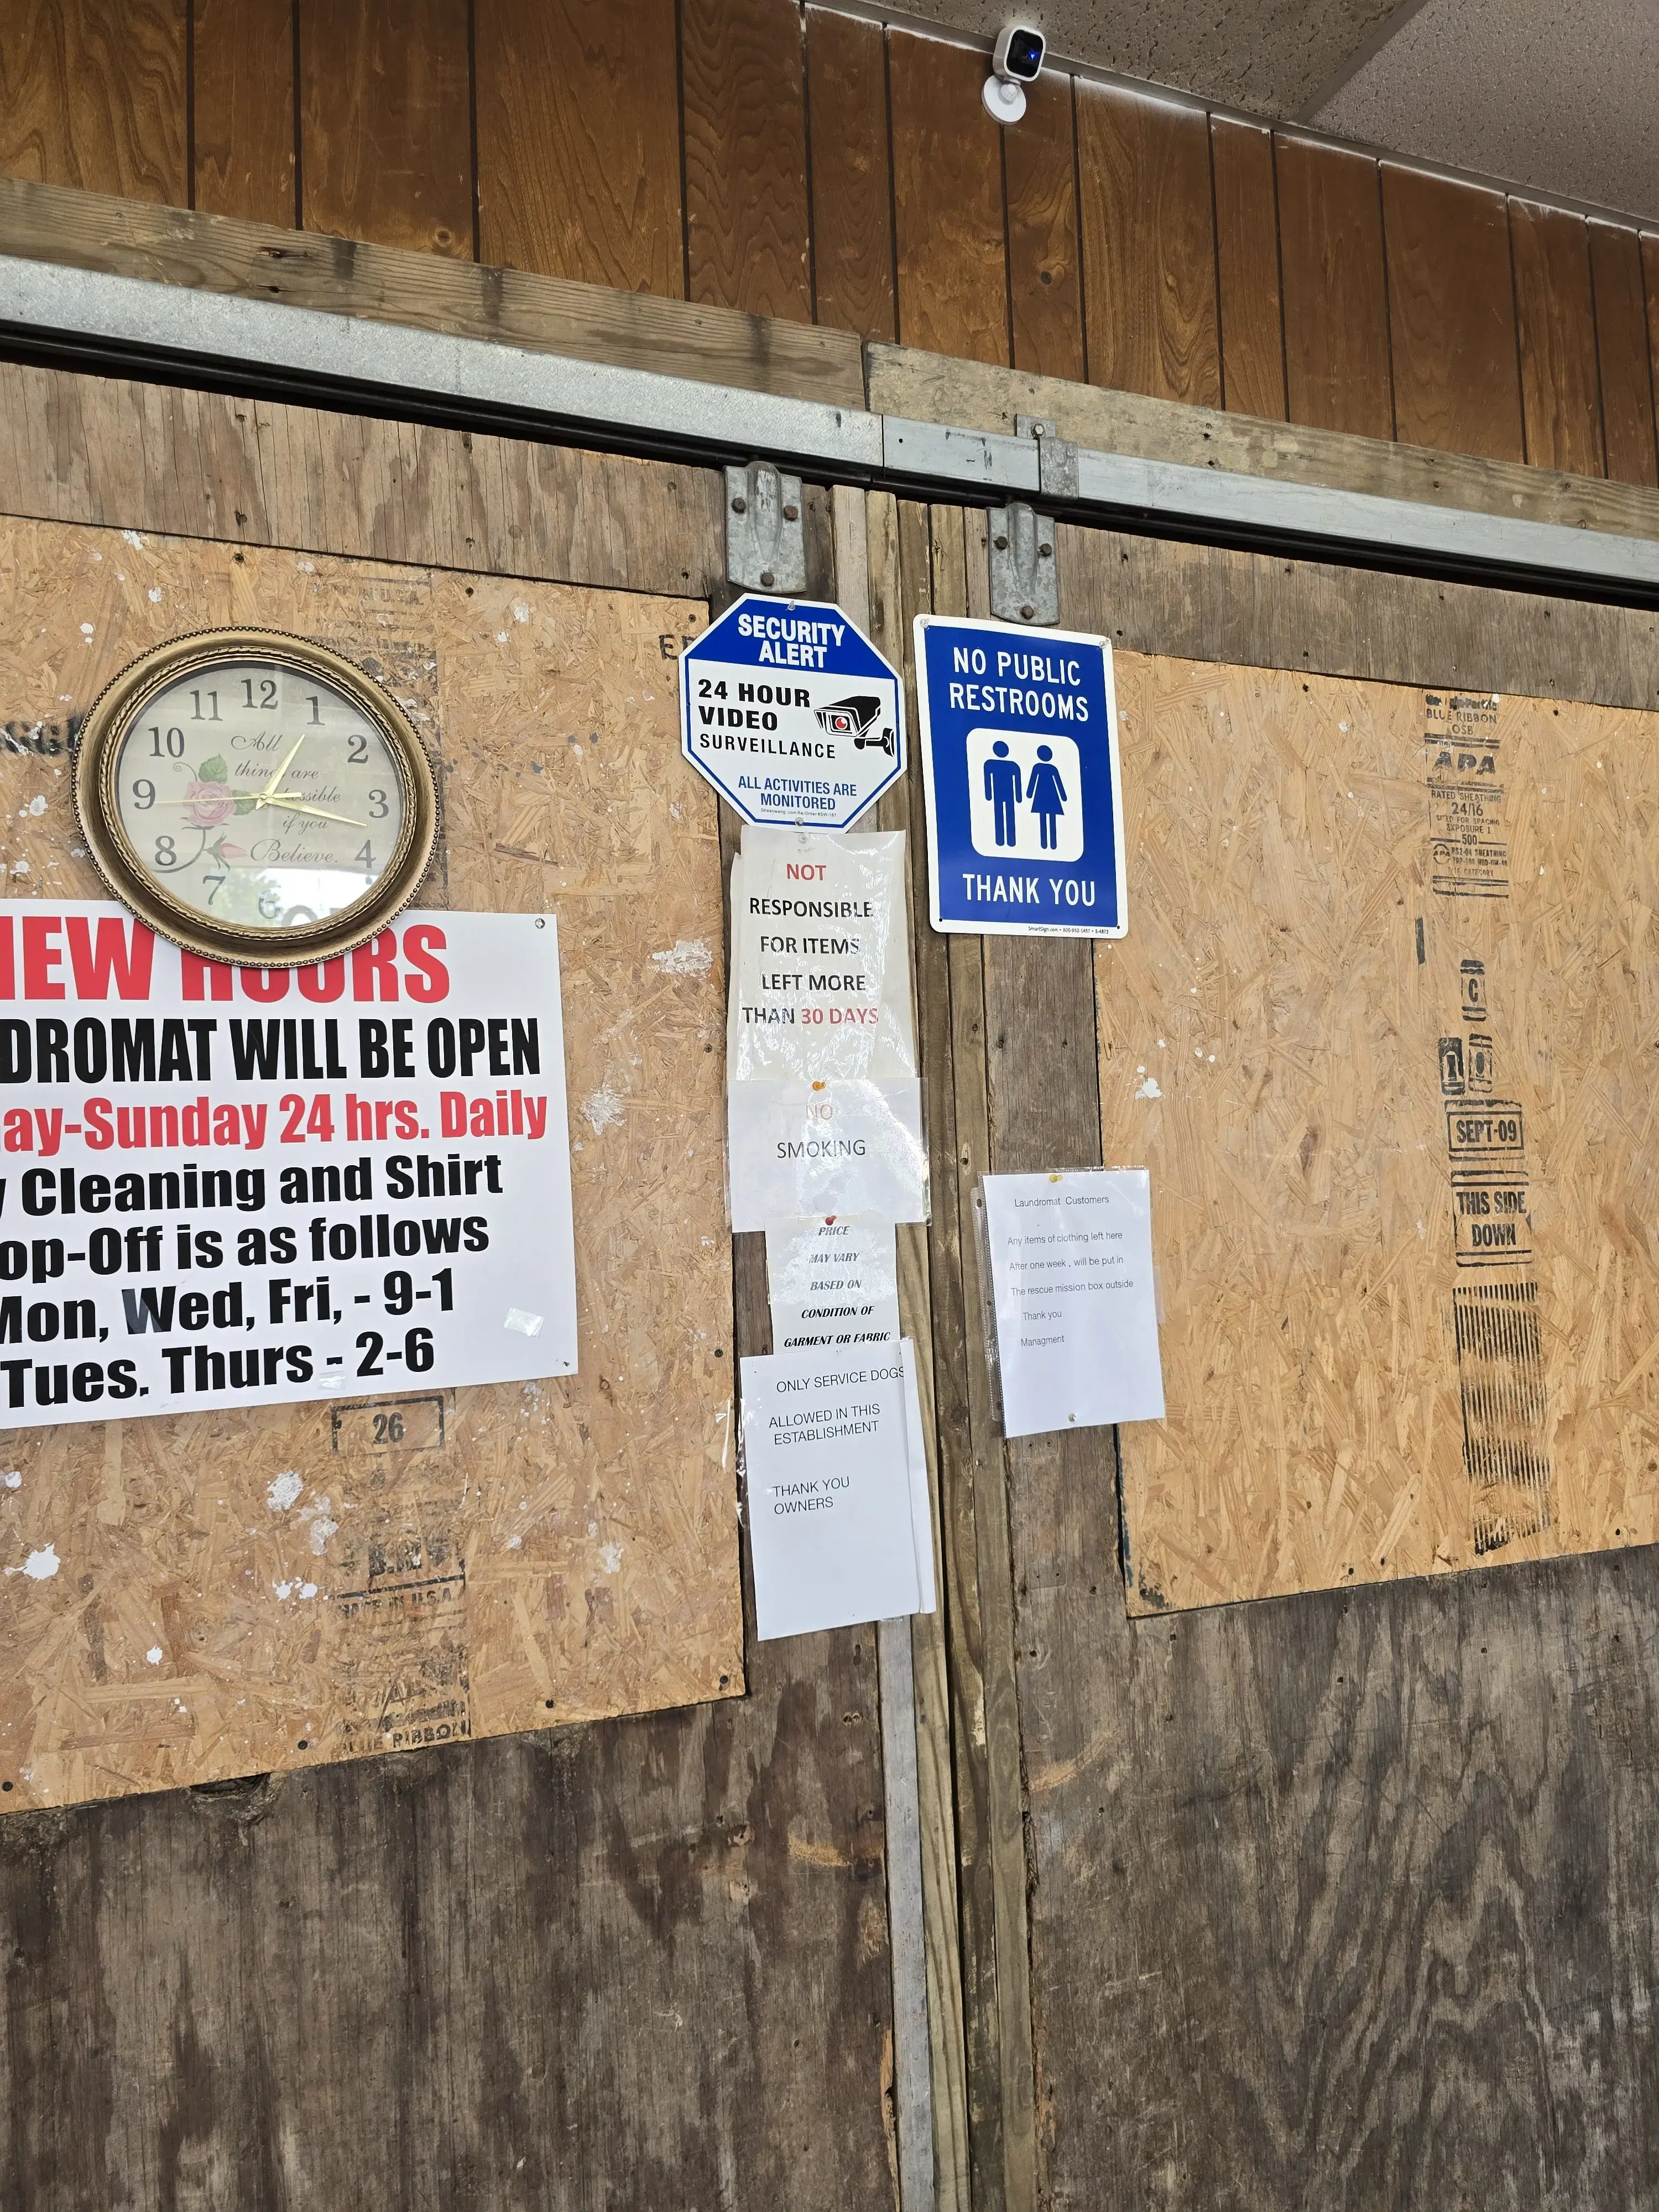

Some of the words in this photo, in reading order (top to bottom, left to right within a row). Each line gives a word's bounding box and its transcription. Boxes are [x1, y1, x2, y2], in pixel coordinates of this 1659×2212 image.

[738, 613, 846, 647] SECURITY
[758, 640, 827, 669] ALERT
[953, 646, 987, 675] NO
[997, 651, 1081, 686] PUBLIC
[190, 690, 223, 722] 11
[241, 679, 279, 710] 12
[698, 679, 728, 700] 24
[738, 682, 811, 708] HOUR
[950, 682, 1089, 722] RESTROOMS
[305, 696, 326, 726] 1
[697, 705, 778, 731] VIDEO
[1426, 708, 1452, 720] BLUE
[1456, 711, 1497, 724] RIBBON
[231, 731, 283, 752] All
[1452, 723, 1474, 735] OSB
[148, 727, 185, 758] 10
[347, 734, 368, 765] 2
[700, 733, 836, 759] SURVEILLANCE
[234, 759, 287, 779] thin
[291, 769, 319, 780] are
[1432, 751, 1496, 775] APA
[132, 779, 157, 810] 9
[281, 785, 341, 803] ssible
[738, 775, 761, 790] ALL
[764, 778, 831, 795] ACTIVITIES
[833, 782, 857, 796] ARE
[1431, 790, 1456, 800] RATED
[1460, 792, 1502, 803] SHEATHING
[368, 789, 389, 819] 3
[760, 792, 836, 811] MONITORED
[1451, 802, 1484, 817] 24/16
[283, 812, 300, 834] if
[298, 821, 328, 836] you
[155, 836, 177, 867] 8
[250, 838, 338, 863] Believe.
[1462, 833, 1478, 846] 500
[354, 840, 377, 869] 4
[1474, 849, 1507, 858] SHEATHING
[786, 863, 827, 881] NOT
[202, 875, 226, 906] 7
[962, 873, 1040, 904] THANK
[1048, 878, 1095, 906] YOU
[257, 889, 281, 920] 6
[749, 897, 874, 918] RESPONSIBLE
[760, 936, 797, 953] FOR
[803, 937, 861, 954] ITEMS
[761, 973, 803, 990] LEFT
[808, 974, 866, 992] MORE
[1467, 978, 1479, 1003] C
[742, 1006, 795, 1024] THAN
[801, 1008, 824, 1025] 30
[830, 1008, 879, 1025] DAYS
[0, 1016, 217, 1083] DROMAT
[228, 1018, 347, 1081] WILL
[359, 1018, 416, 1079] BE
[426, 1017, 541, 1077] OPEN
[0, 1096, 268, 1157] ay-Sunday
[279, 1093, 335, 1144] 24
[346, 1093, 430, 1141] hrs.
[441, 1089, 547, 1140] Daily
[807, 1103, 833, 1120] NO
[1455, 1119, 1517, 1144] SEPT-09
[776, 1139, 866, 1160] SMOKING
[21, 1162, 266, 1217] Cleaning
[279, 1156, 373, 1204] and
[385, 1153, 503, 1200] Shirt
[1014, 1197, 1061, 1208] Laundromat
[1065, 1194, 1110, 1206] Customers
[1455, 1191, 1491, 1216] THIS
[1493, 1190, 1527, 1214] SIDE
[818, 1225, 850, 1237] PRICE
[1007, 1235, 1022, 1248] Any
[1024, 1234, 1046, 1245] items
[1047, 1233, 1056, 1243] of
[1056, 1232, 1089, 1244] clothing
[1091, 1231, 1104, 1241] left
[1105, 1230, 1123, 1240] here
[1471, 1222, 1517, 1248] DOWN
[0, 1224, 163, 1284] op-Off
[176, 1222, 223, 1271] is
[237, 1223, 297, 1267] as
[309, 1214, 489, 1263] follows
[808, 1253, 832, 1265] MAY
[833, 1251, 860, 1264] VARY
[1009, 1261, 1028, 1272] After
[1029, 1261, 1045, 1271] one
[1046, 1258, 1066, 1269] week
[1073, 1256, 1087, 1267] will
[1088, 1256, 1100, 1266] be
[1101, 1255, 1115, 1267] put
[1116, 1255, 1124, 1264] in
[810, 1280, 844, 1291] BASED
[846, 1279, 863, 1290] ON
[1011, 1287, 1026, 1297] The
[1027, 1285, 1053, 1295] rescue
[1055, 1282, 1086, 1292] mission
[1088, 1281, 1104, 1291] box
[1105, 1279, 1134, 1290] outside
[121, 1281, 255, 1334] Wed,
[268, 1275, 343, 1325] Fri,
[354, 1295, 370, 1304] -
[383, 1267, 455, 1316] 9-1
[800, 1307, 858, 1319] CONDITION
[860, 1306, 875, 1316] OF
[1022, 1310, 1047, 1322] Thank
[1047, 1310, 1062, 1321] you
[784, 1334, 834, 1348] GARMENT
[836, 1333, 851, 1345] OR
[853, 1331, 891, 1343] FABRIC
[1020, 1334, 1065, 1348] Managment
[0, 1355, 150, 1410] Tues.
[161, 1342, 315, 1395] Thurs
[356, 1327, 435, 1378] 2-6
[776, 1377, 811, 1394] ONLY
[813, 1371, 868, 1389] SERVICE
[870, 1365, 904, 1381] DOGS
[372, 1411, 406, 1445] 26
[769, 1409, 833, 1429] ALLOWED
[836, 1407, 848, 1420] IN
[850, 1402, 881, 1419] THIS
[774, 1420, 879, 1446] ESTABLISHMENT
[772, 1479, 820, 1498] THANK
[822, 1476, 851, 1491] YOU
[774, 1496, 834, 1516] OWNERS
